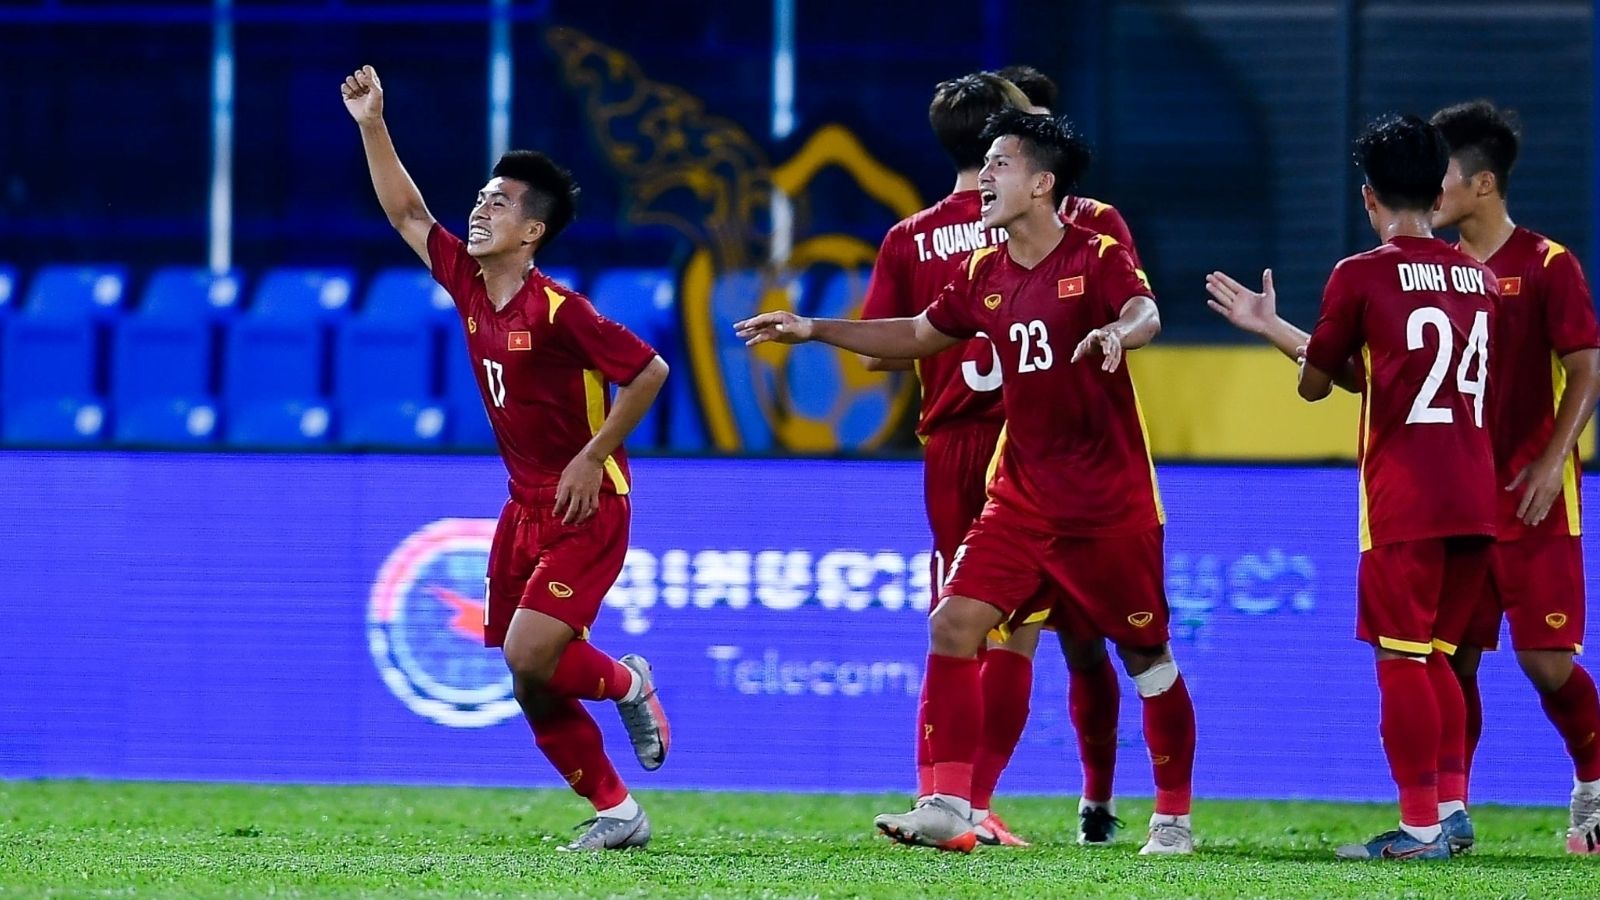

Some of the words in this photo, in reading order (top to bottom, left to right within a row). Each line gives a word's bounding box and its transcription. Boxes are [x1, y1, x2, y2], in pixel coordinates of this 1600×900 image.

[914, 232, 932, 262] T.
[932, 220, 987, 261] QUANG
[1397, 263, 1447, 292] DINH
[1450, 265, 1485, 295] QUY
[1009, 319, 1053, 373] 23
[1405, 306, 1488, 428] 24
[482, 358, 505, 408] 17
[706, 645, 922, 695] Telecom
